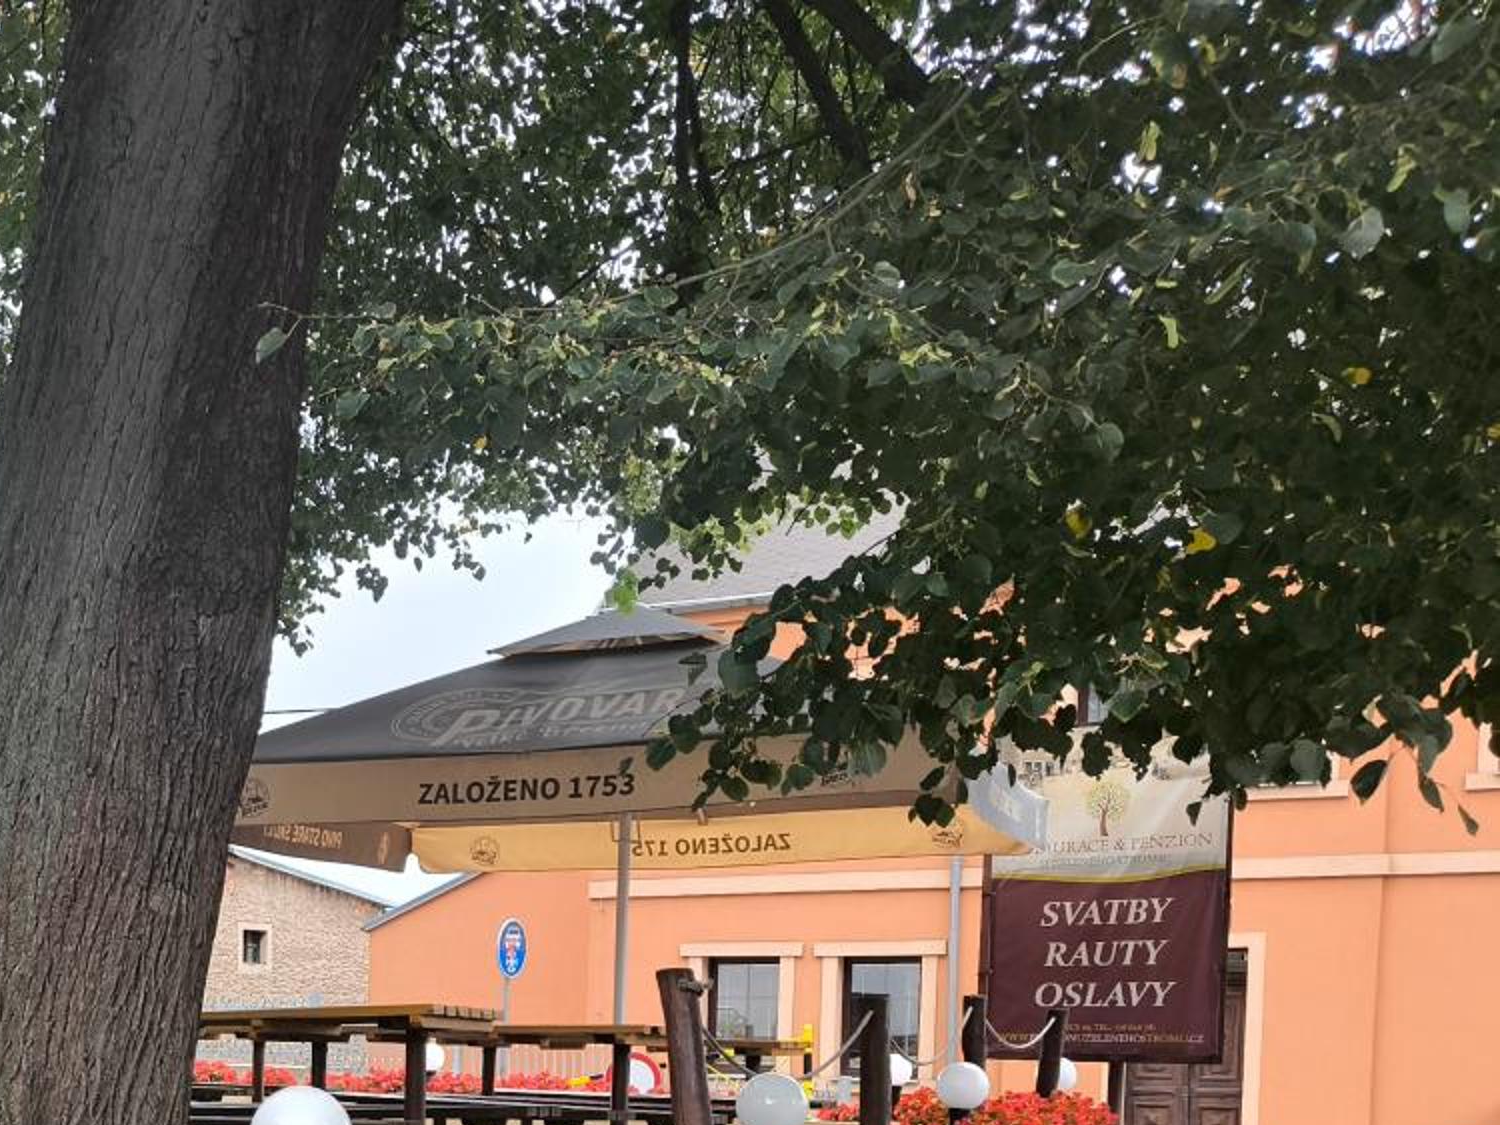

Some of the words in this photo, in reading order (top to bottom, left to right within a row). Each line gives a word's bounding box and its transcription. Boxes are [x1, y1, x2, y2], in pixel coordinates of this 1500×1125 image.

[418, 776, 560, 805] ZALOŽENO
[569, 773, 635, 798] 1753
[1040, 897, 1173, 928] SVATBY
[1044, 940, 1170, 968] RAUTY
[1035, 981, 1178, 1008] OSLAVY
